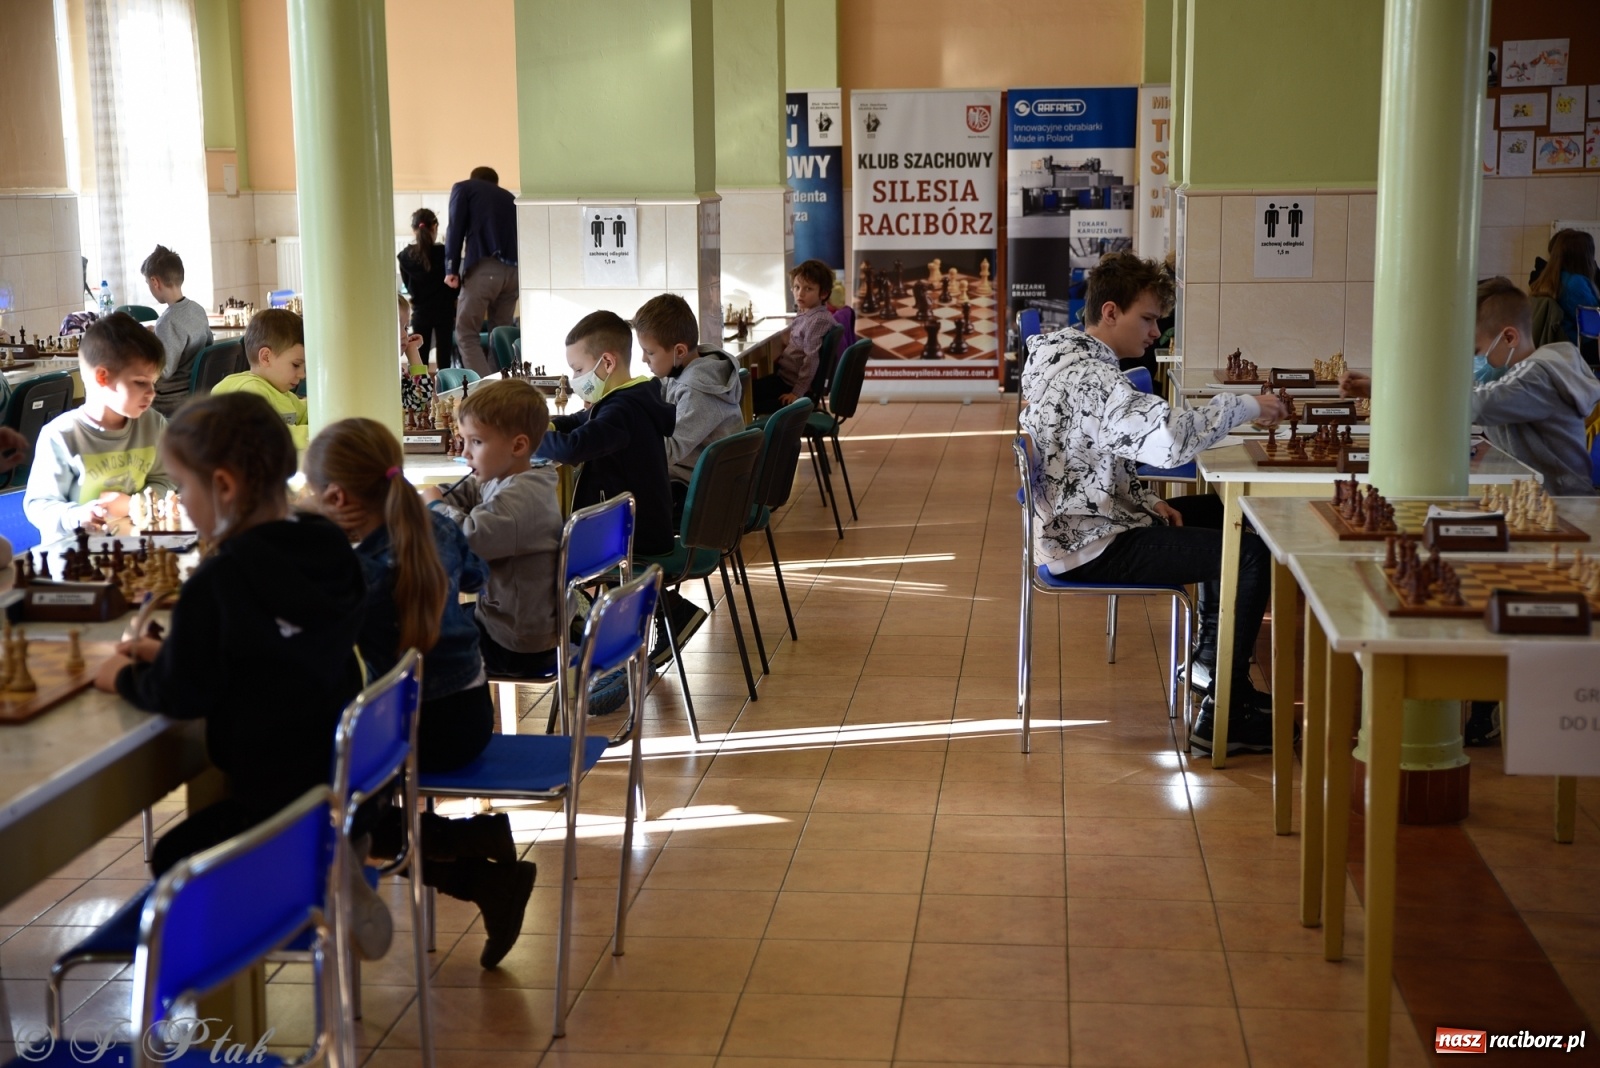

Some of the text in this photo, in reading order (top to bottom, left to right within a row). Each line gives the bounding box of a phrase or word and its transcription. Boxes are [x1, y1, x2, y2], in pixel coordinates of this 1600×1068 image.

[1037, 102, 1082, 113] RAFAMET
[1013, 122, 1103, 133] Innowacyjne obrabiarki
[1013, 134, 1074, 143] Made in Poland
[858, 152, 994, 170] KLUB SZACHOWY
[872, 179, 979, 203] SILESIA
[858, 206, 994, 236] RACIBÓRZ
[1559, 716, 1588, 732] DO
